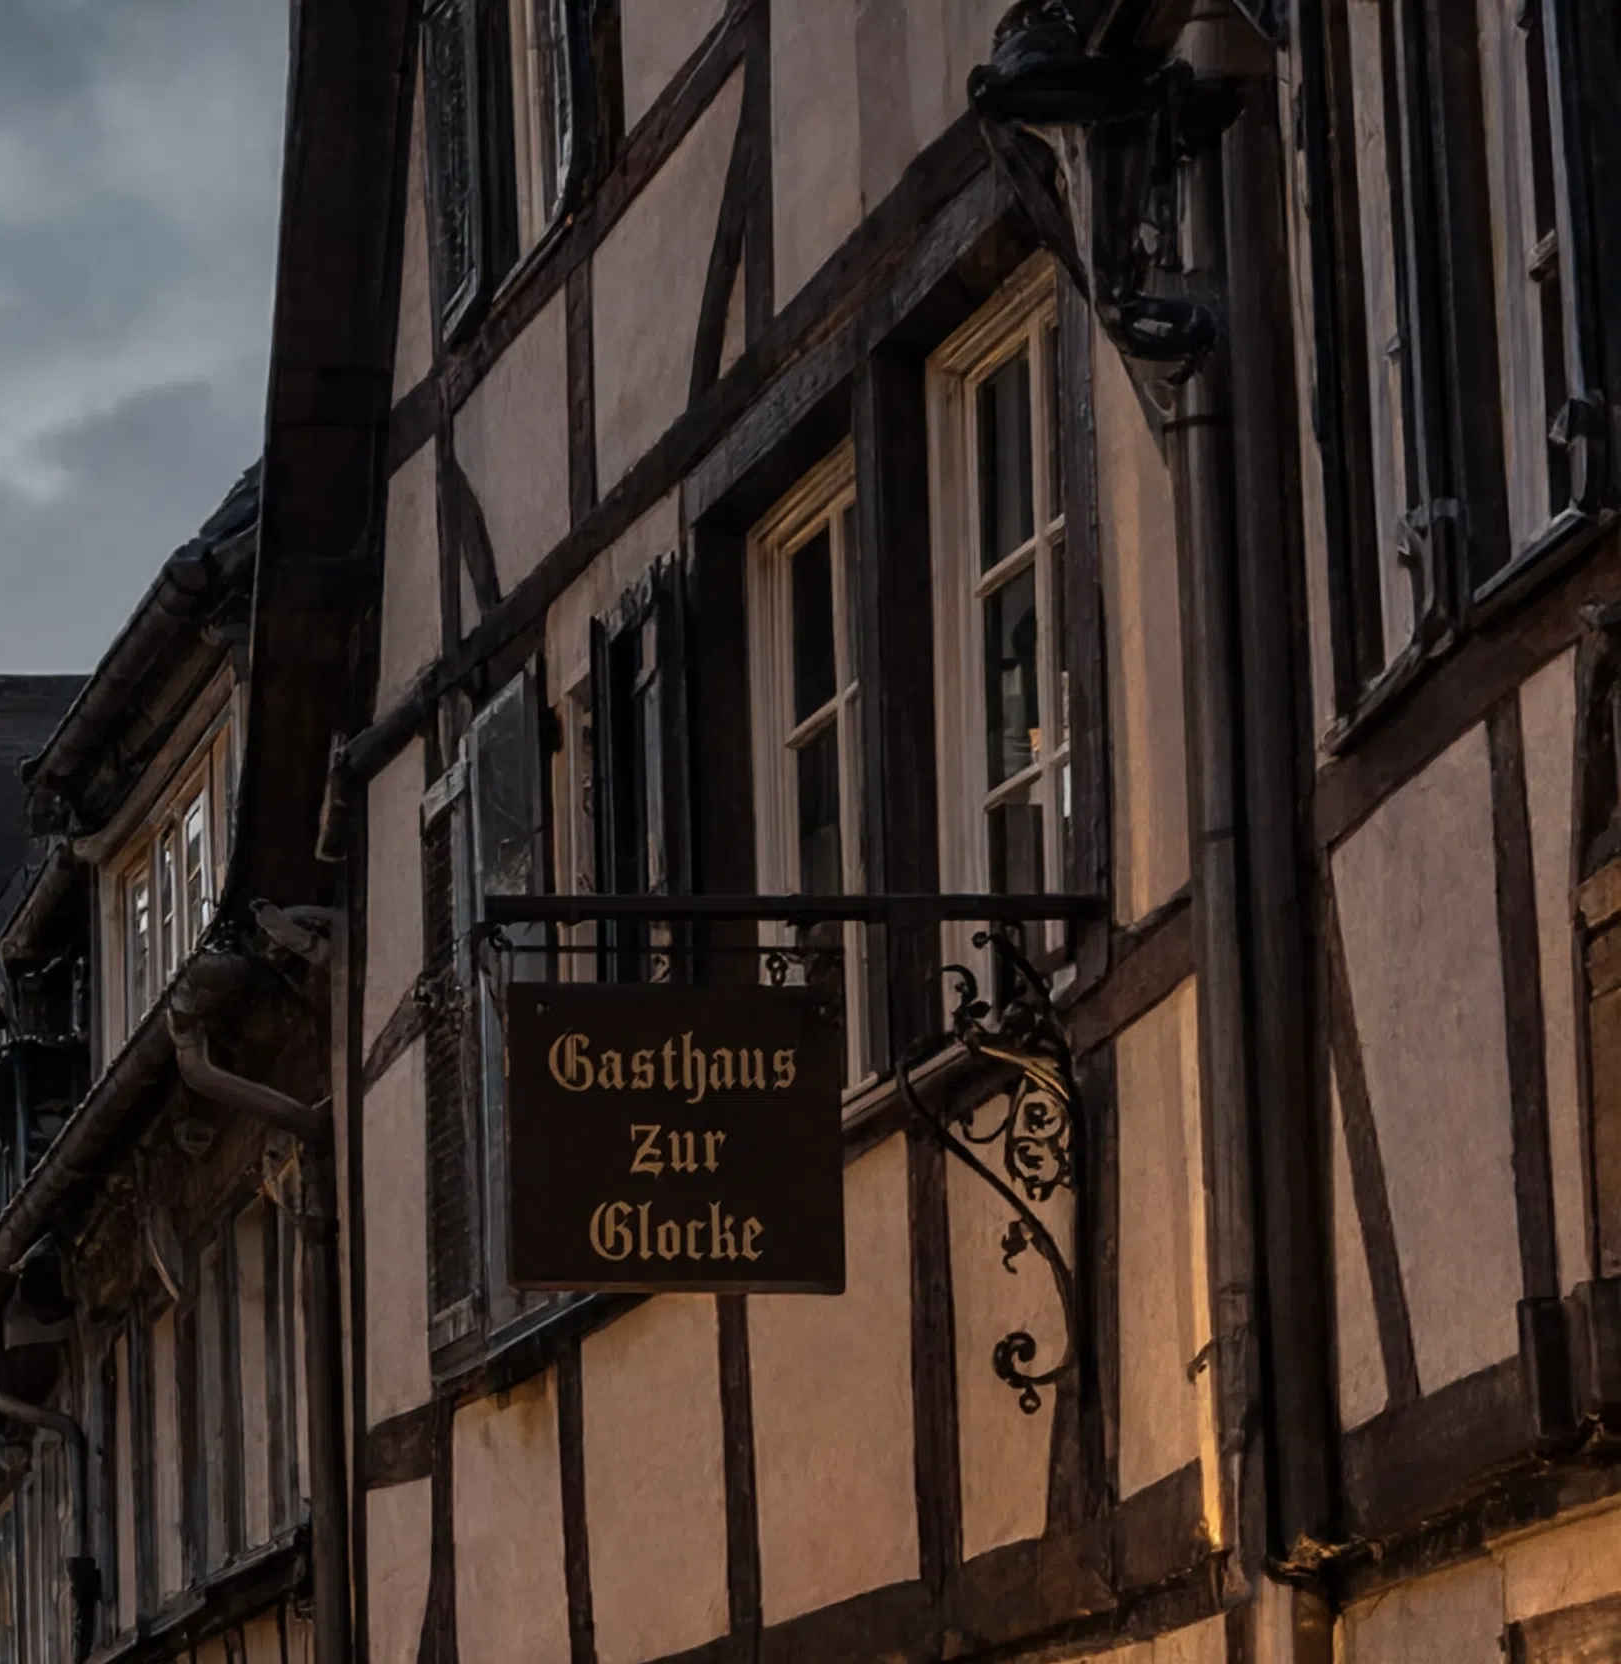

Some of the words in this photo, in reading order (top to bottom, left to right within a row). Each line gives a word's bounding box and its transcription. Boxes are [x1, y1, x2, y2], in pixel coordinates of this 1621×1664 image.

[549, 1028, 796, 1104] Gasthaus
[630, 1123, 727, 1178] Zur
[589, 1200, 764, 1262] Glocke
